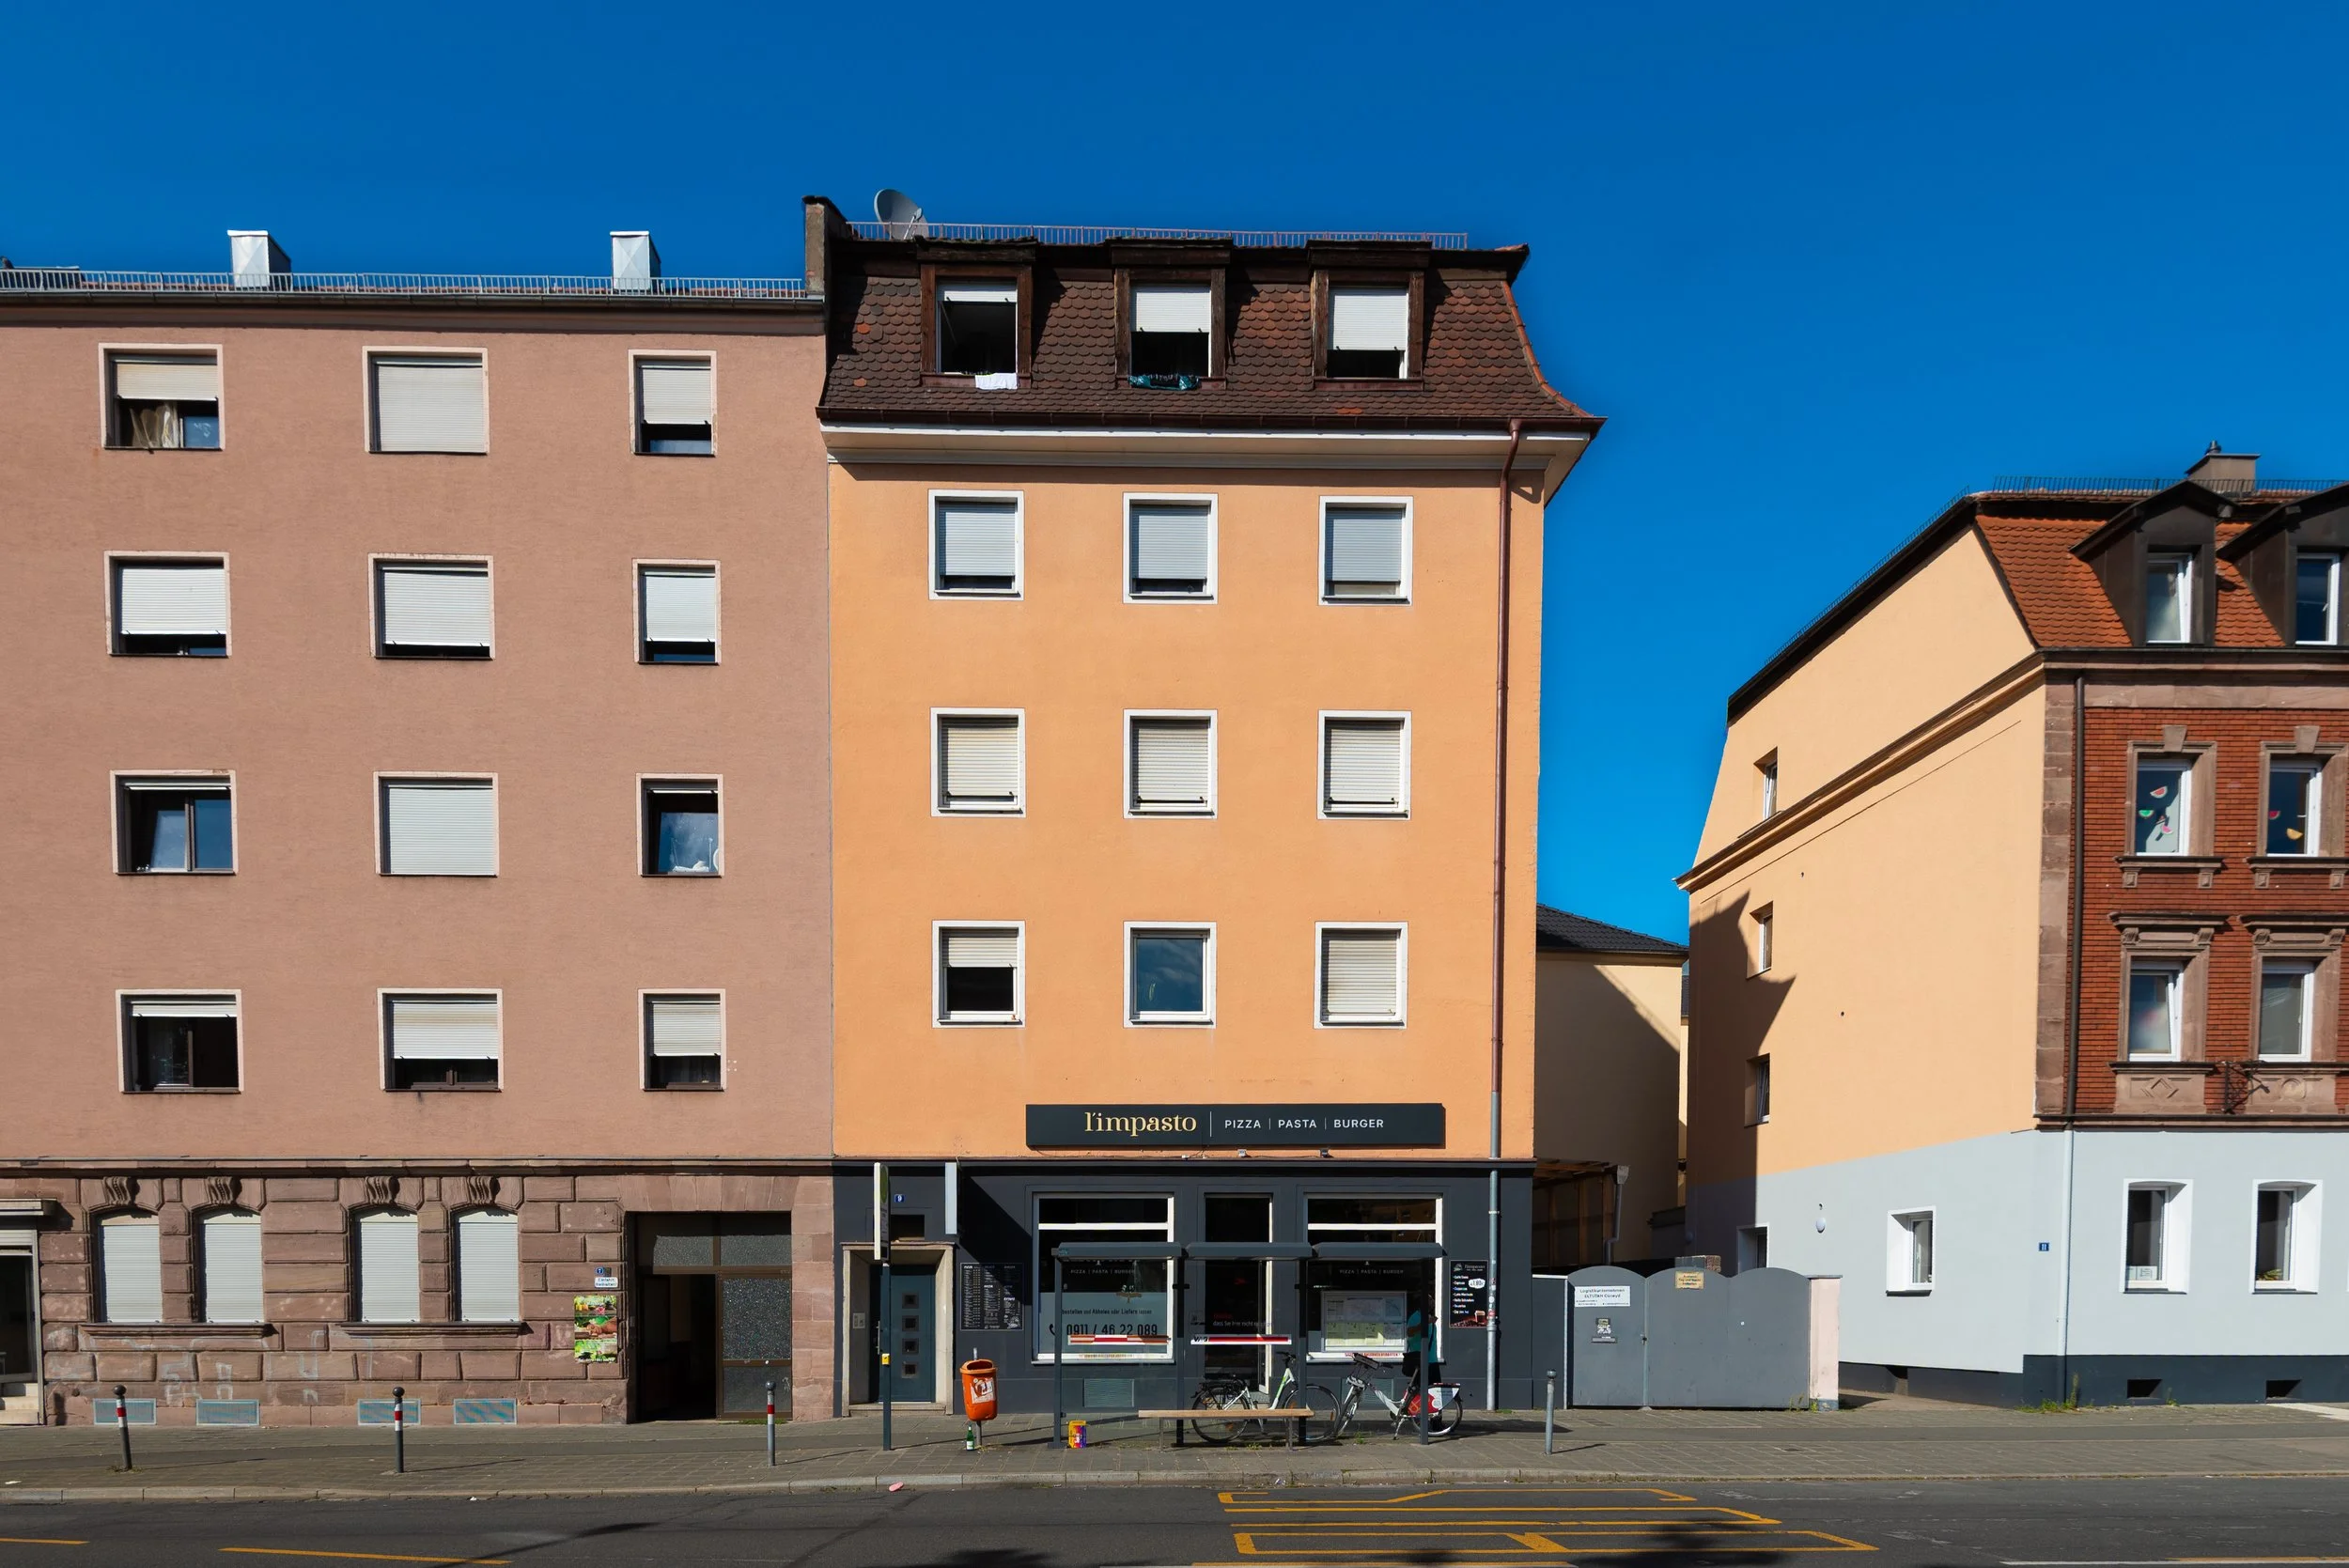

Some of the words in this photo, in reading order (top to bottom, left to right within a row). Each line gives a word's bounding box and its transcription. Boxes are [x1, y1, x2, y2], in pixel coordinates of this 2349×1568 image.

[1084, 1111, 1197, 1137] l'impasto
[1224, 1119, 1261, 1128] PIZZA
[1278, 1119, 1317, 1128] PASTA
[1333, 1119, 1384, 1128] BURGER
[897, 1194, 902, 1203] 9
[1066, 1324, 1088, 1335] 0911
[1101, 1324, 1115, 1335] 46
[1119, 1324, 1133, 1335] 22
[1137, 1324, 1158, 1335] 089
